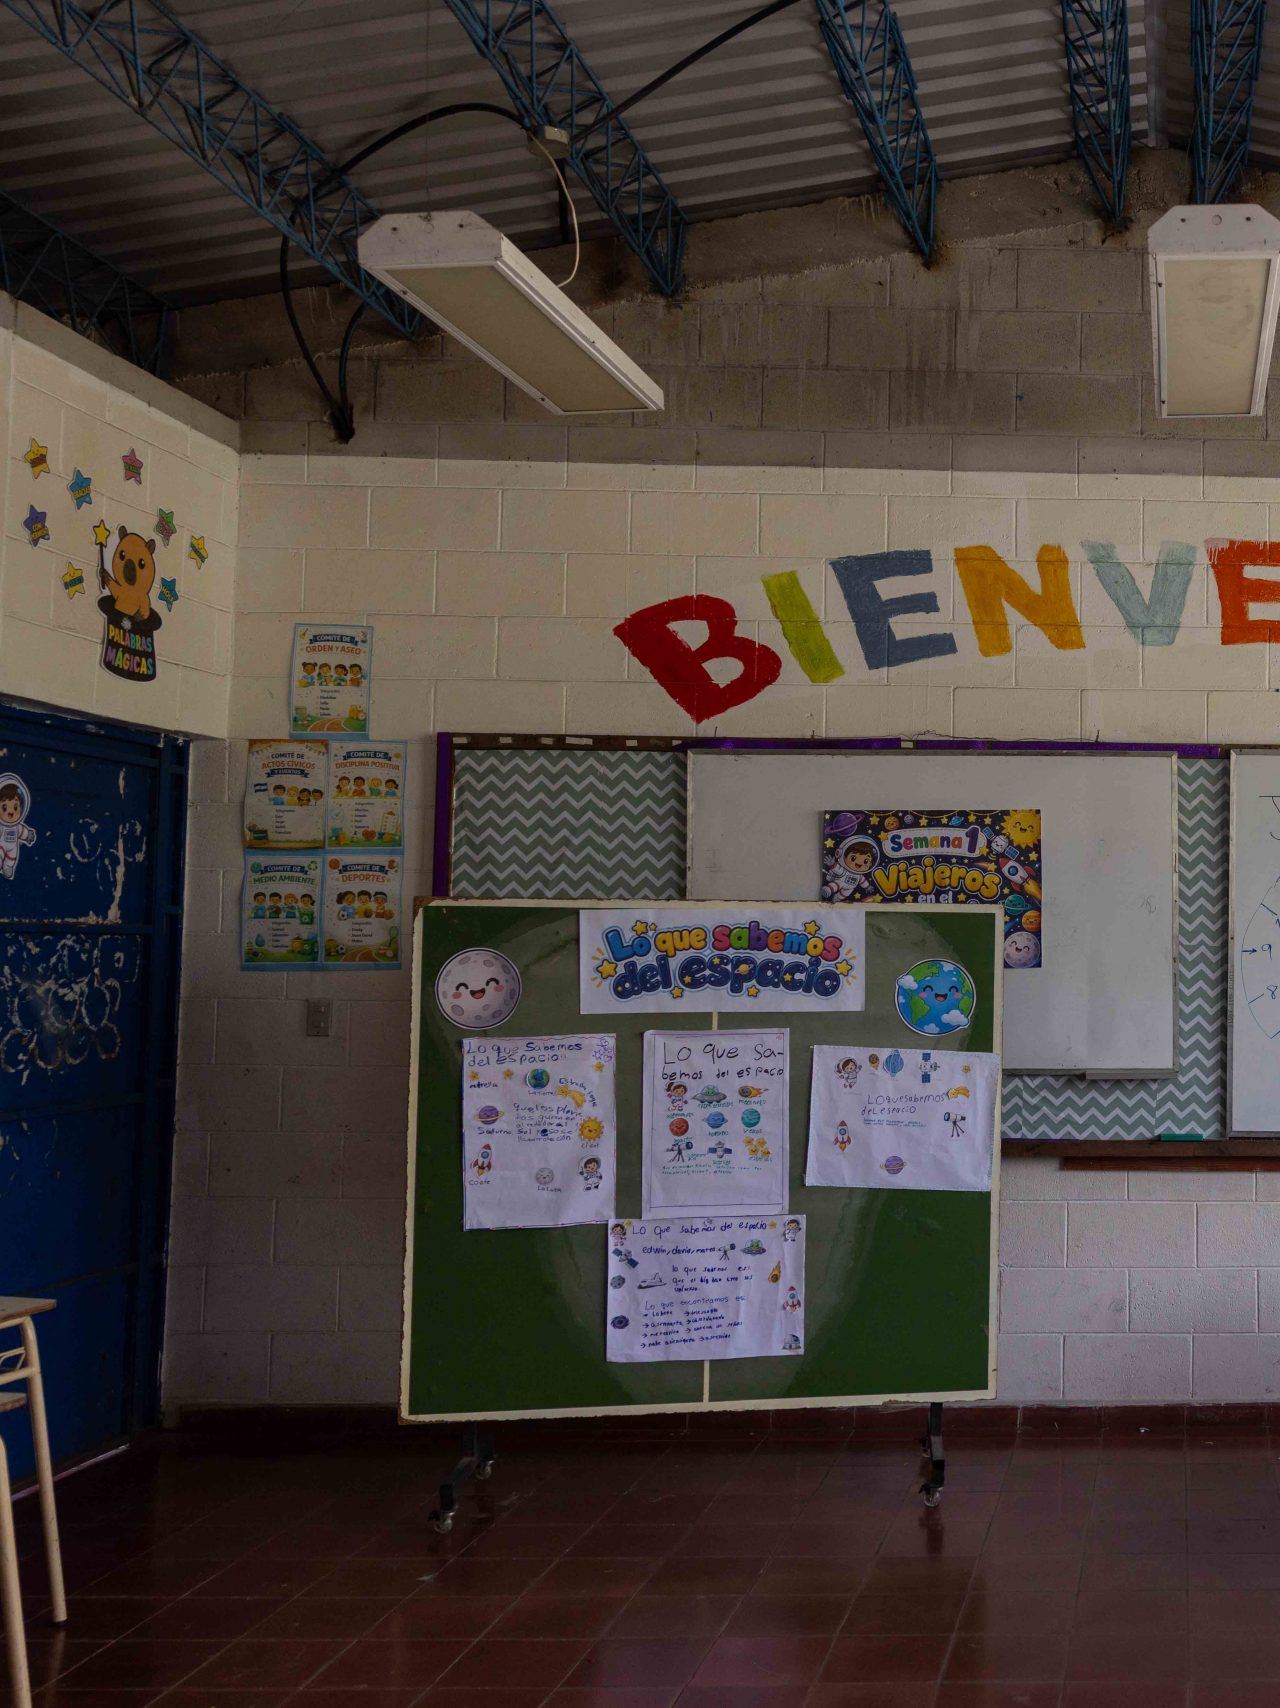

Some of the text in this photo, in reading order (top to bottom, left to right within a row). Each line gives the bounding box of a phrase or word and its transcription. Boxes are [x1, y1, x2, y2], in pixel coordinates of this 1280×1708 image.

[108, 623, 153, 653] PALABRAS
[305, 645, 334, 654] ORDEN
[340, 646, 362, 655] ASEO
[262, 761, 286, 769] ACTOS
[336, 761, 370, 769] DISCIPLINA
[889, 826, 981, 853] Semana 1
[253, 875, 316, 885] MEDIO AMBIENTE
[341, 873, 386, 883] DEPORTES
[872, 856, 1002, 899] Viajeros
[917, 891, 953, 903] en el
[605, 920, 843, 962] Lo que sabemos
[1261, 943, 1273, 961] 9
[613, 953, 841, 999] del espacio
[467, 1041, 487, 1054] Lo
[492, 1045, 519, 1058] que
[663, 1041, 692, 1065] Lo
[703, 1043, 739, 1065] que
[468, 1056, 490, 1067] del
[661, 1065, 703, 1081] bemos
